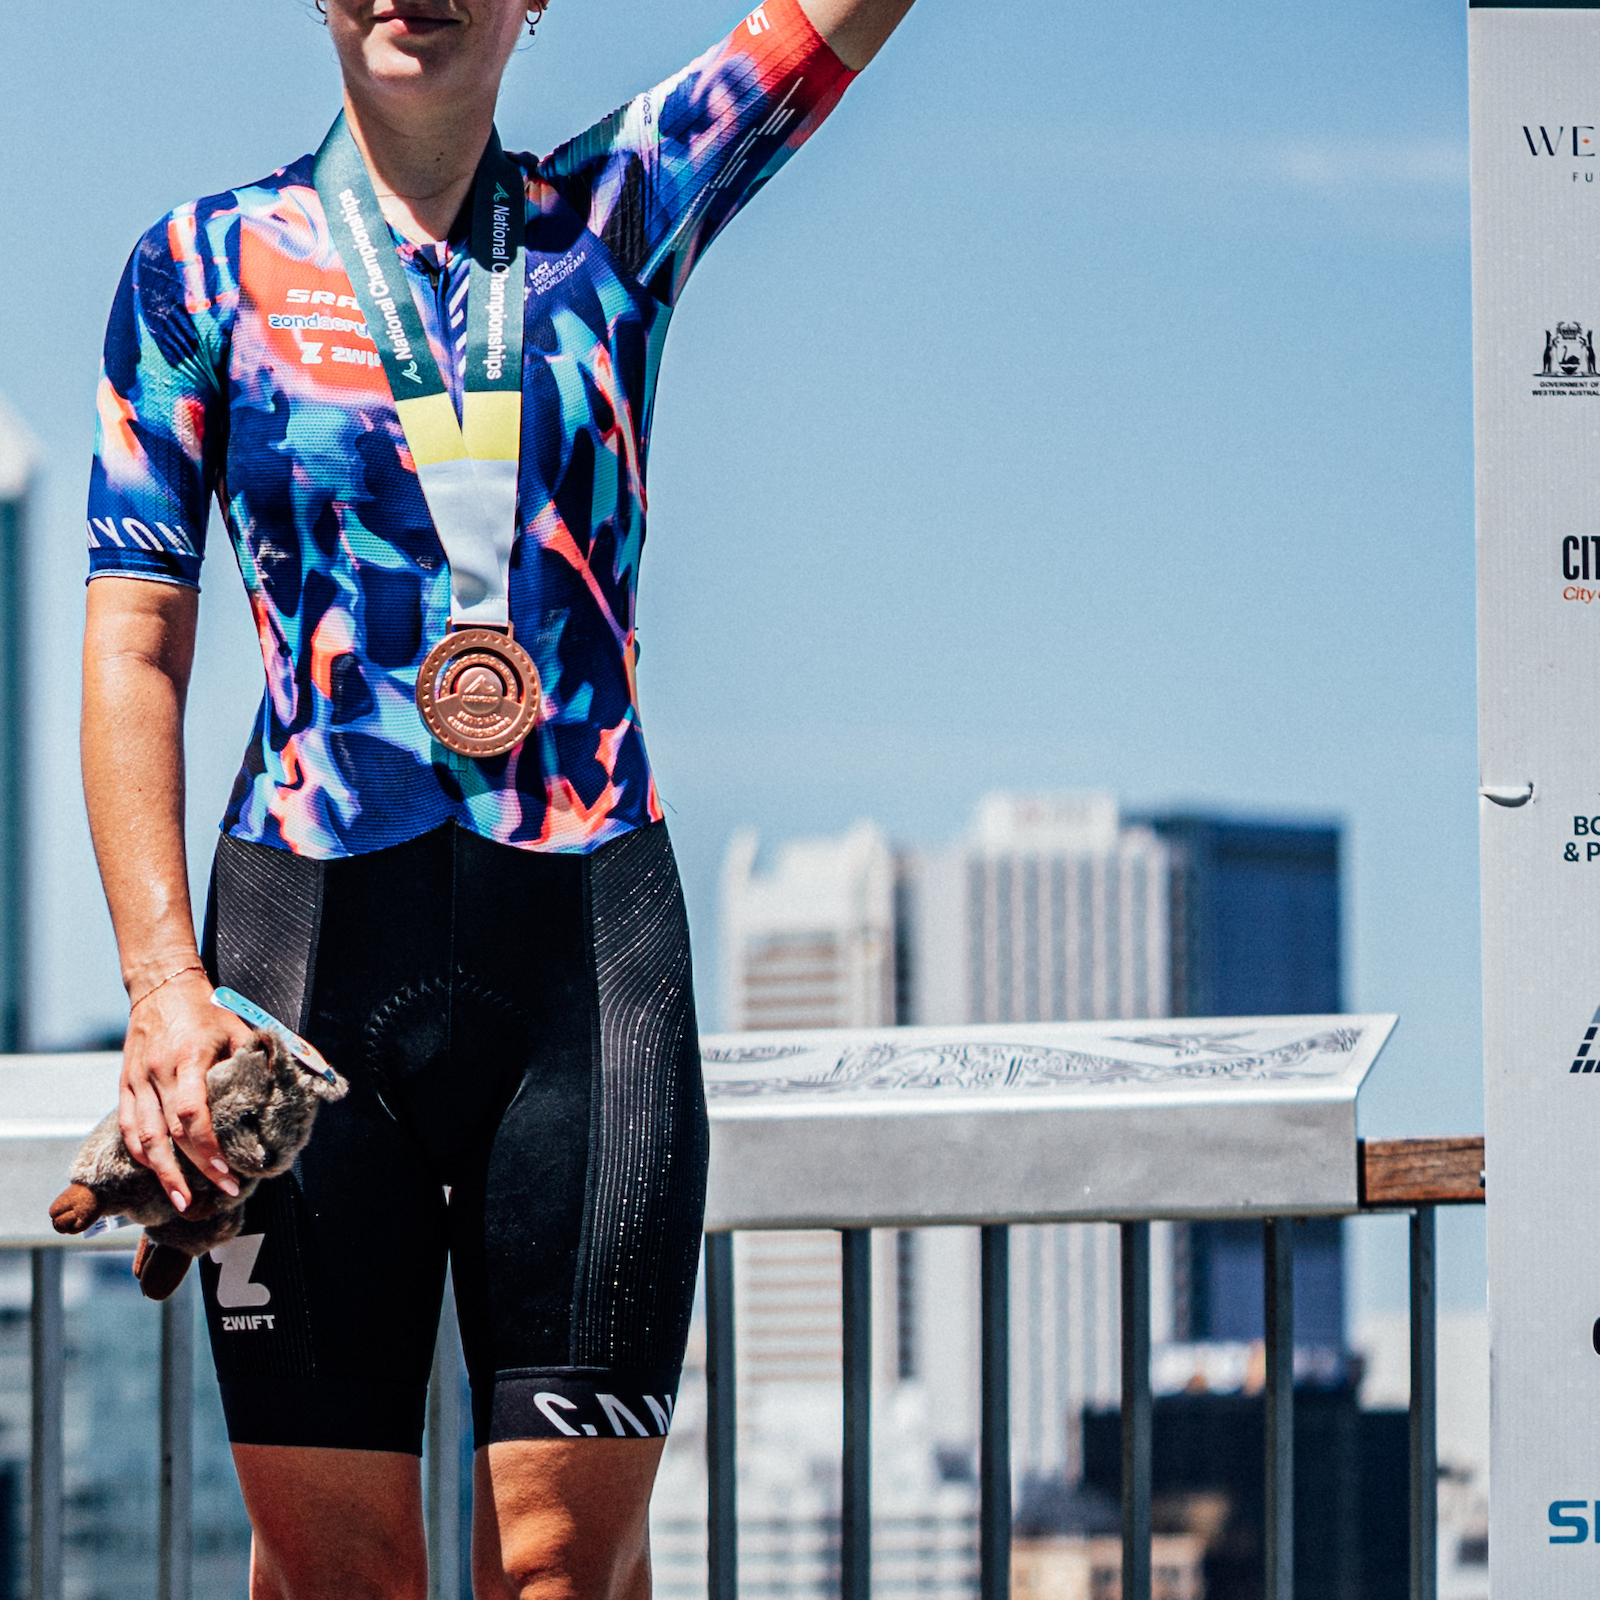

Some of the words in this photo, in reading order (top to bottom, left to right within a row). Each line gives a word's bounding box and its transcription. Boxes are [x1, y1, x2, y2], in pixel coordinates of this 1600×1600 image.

[339, 188, 390, 299] Championships
[492, 204, 511, 260] National
[529, 261, 550, 280] UCI
[534, 251, 586, 296] WORLDTEAM
[286, 289, 362, 311] SRA
[269, 313, 371, 337] zondacry
[374, 297, 413, 361] National
[483, 261, 511, 380] Championships
[331, 346, 382, 368] ZWI
[221, 1314, 275, 1331] ZWIFT
